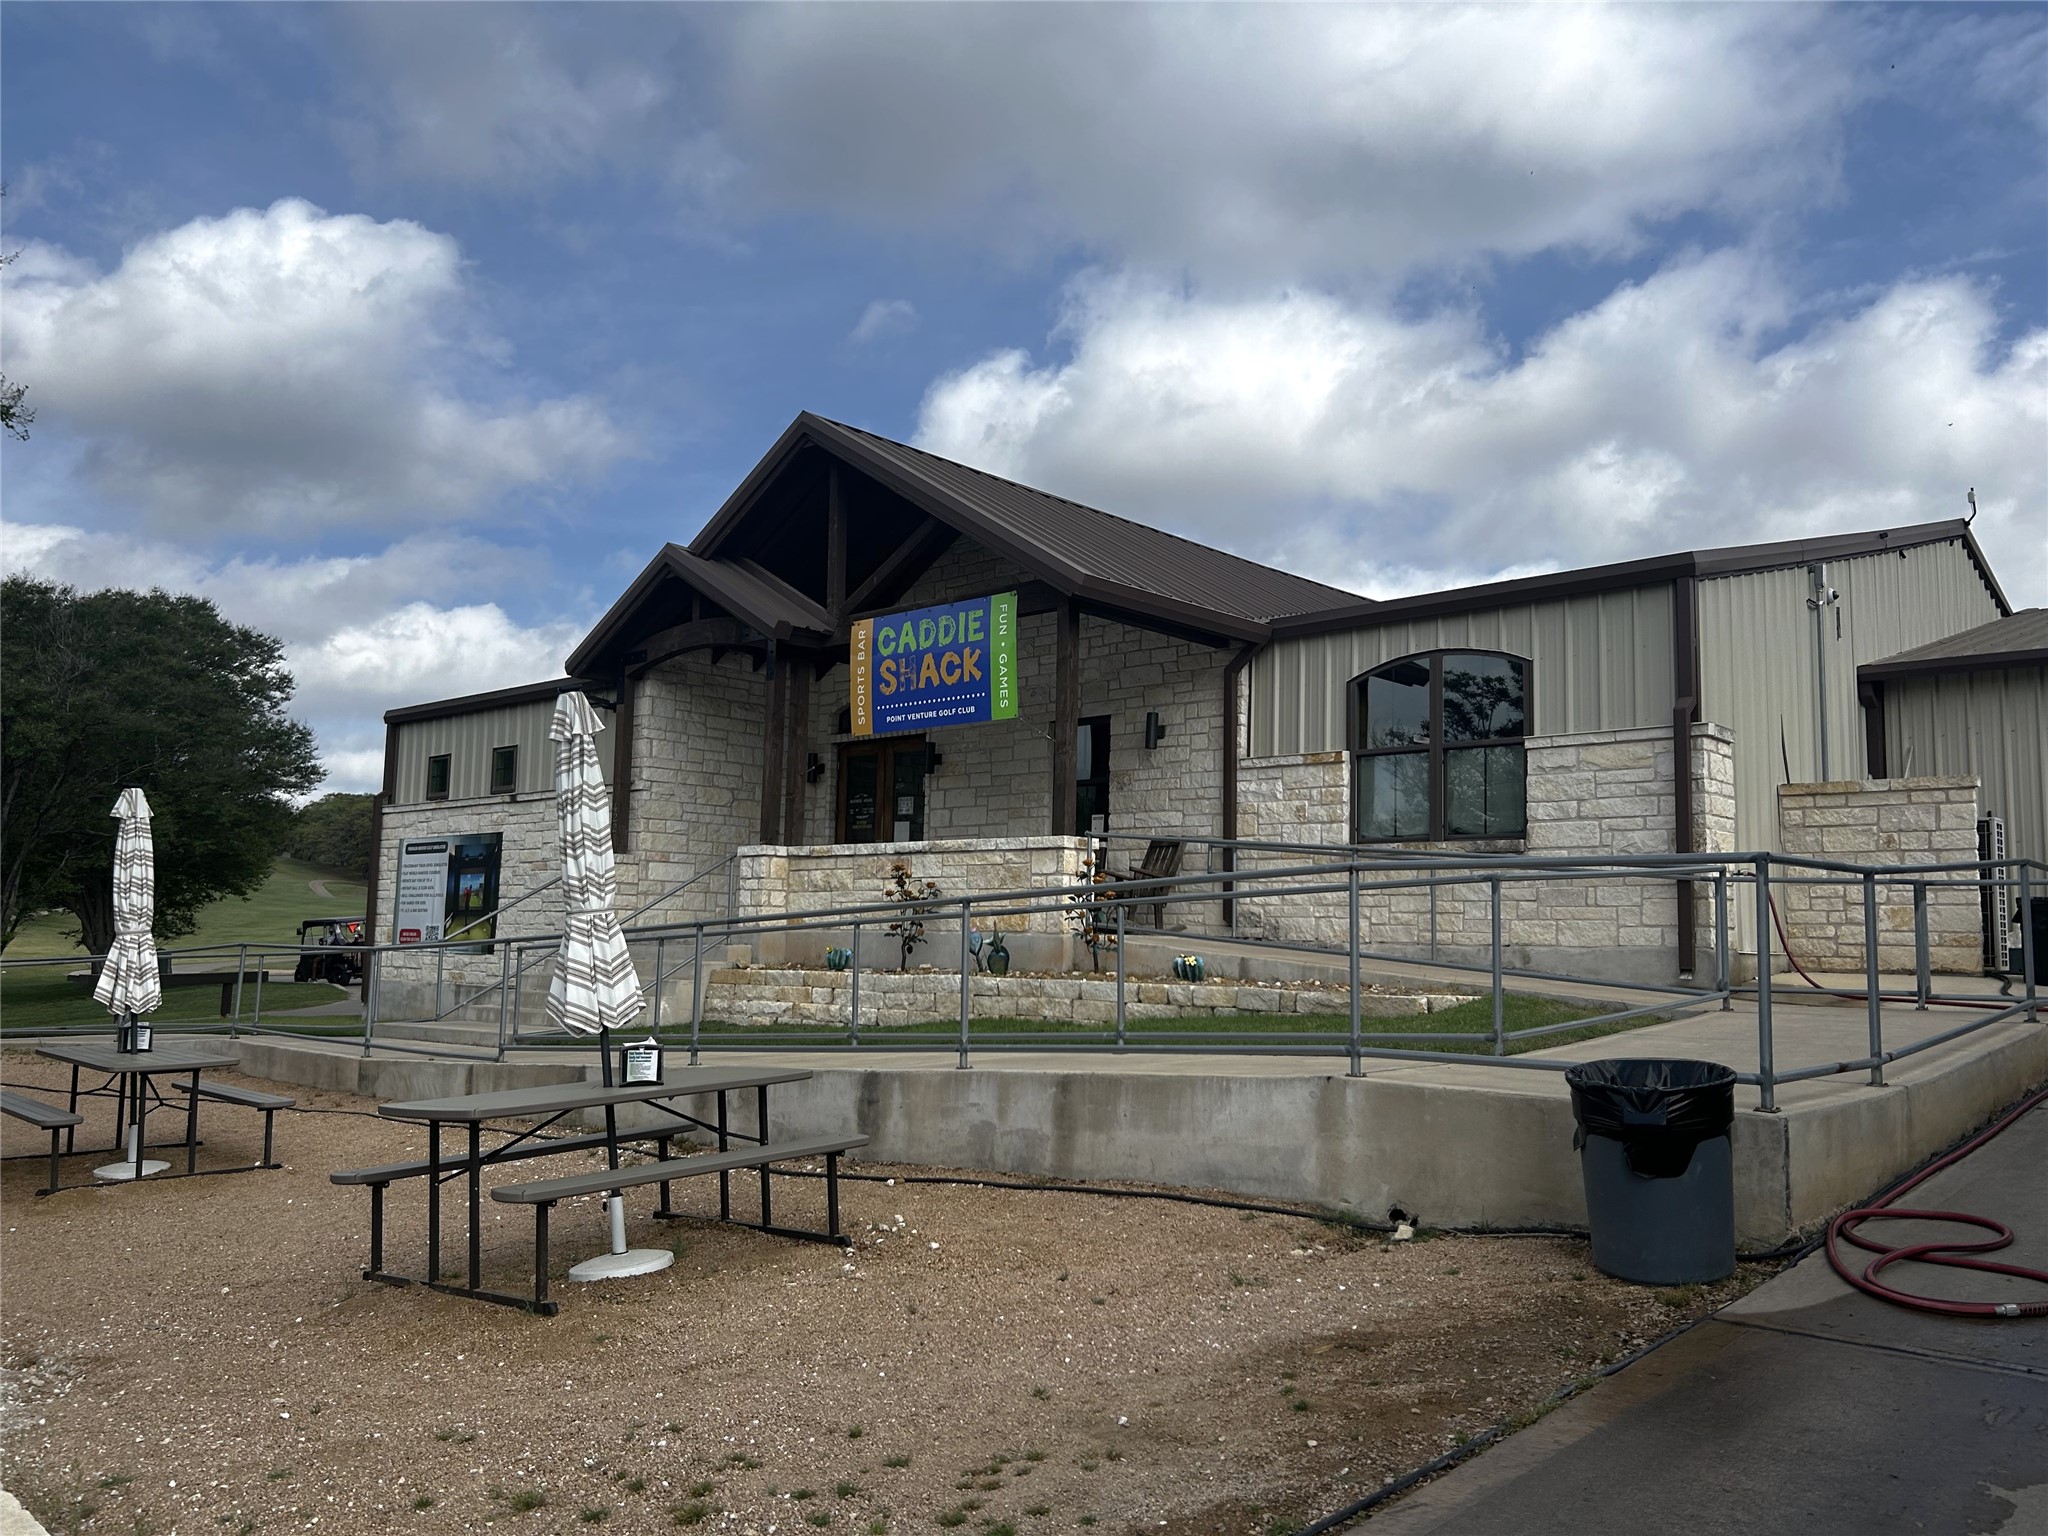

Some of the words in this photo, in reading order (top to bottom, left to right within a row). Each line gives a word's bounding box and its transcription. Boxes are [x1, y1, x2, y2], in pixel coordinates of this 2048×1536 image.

[877, 609, 984, 657] CADDIE
[999, 603, 1008, 635] FUN
[857, 630, 866, 661] BAR
[879, 646, 983, 696] SHACK
[999, 653, 1009, 708] GAMES
[857, 666, 866, 725] SPORTS
[886, 715, 906, 723] POINT
[907, 710, 938, 721] VENTURE
[938, 708, 956, 717] GOLF
[957, 705, 976, 714] CLUB
